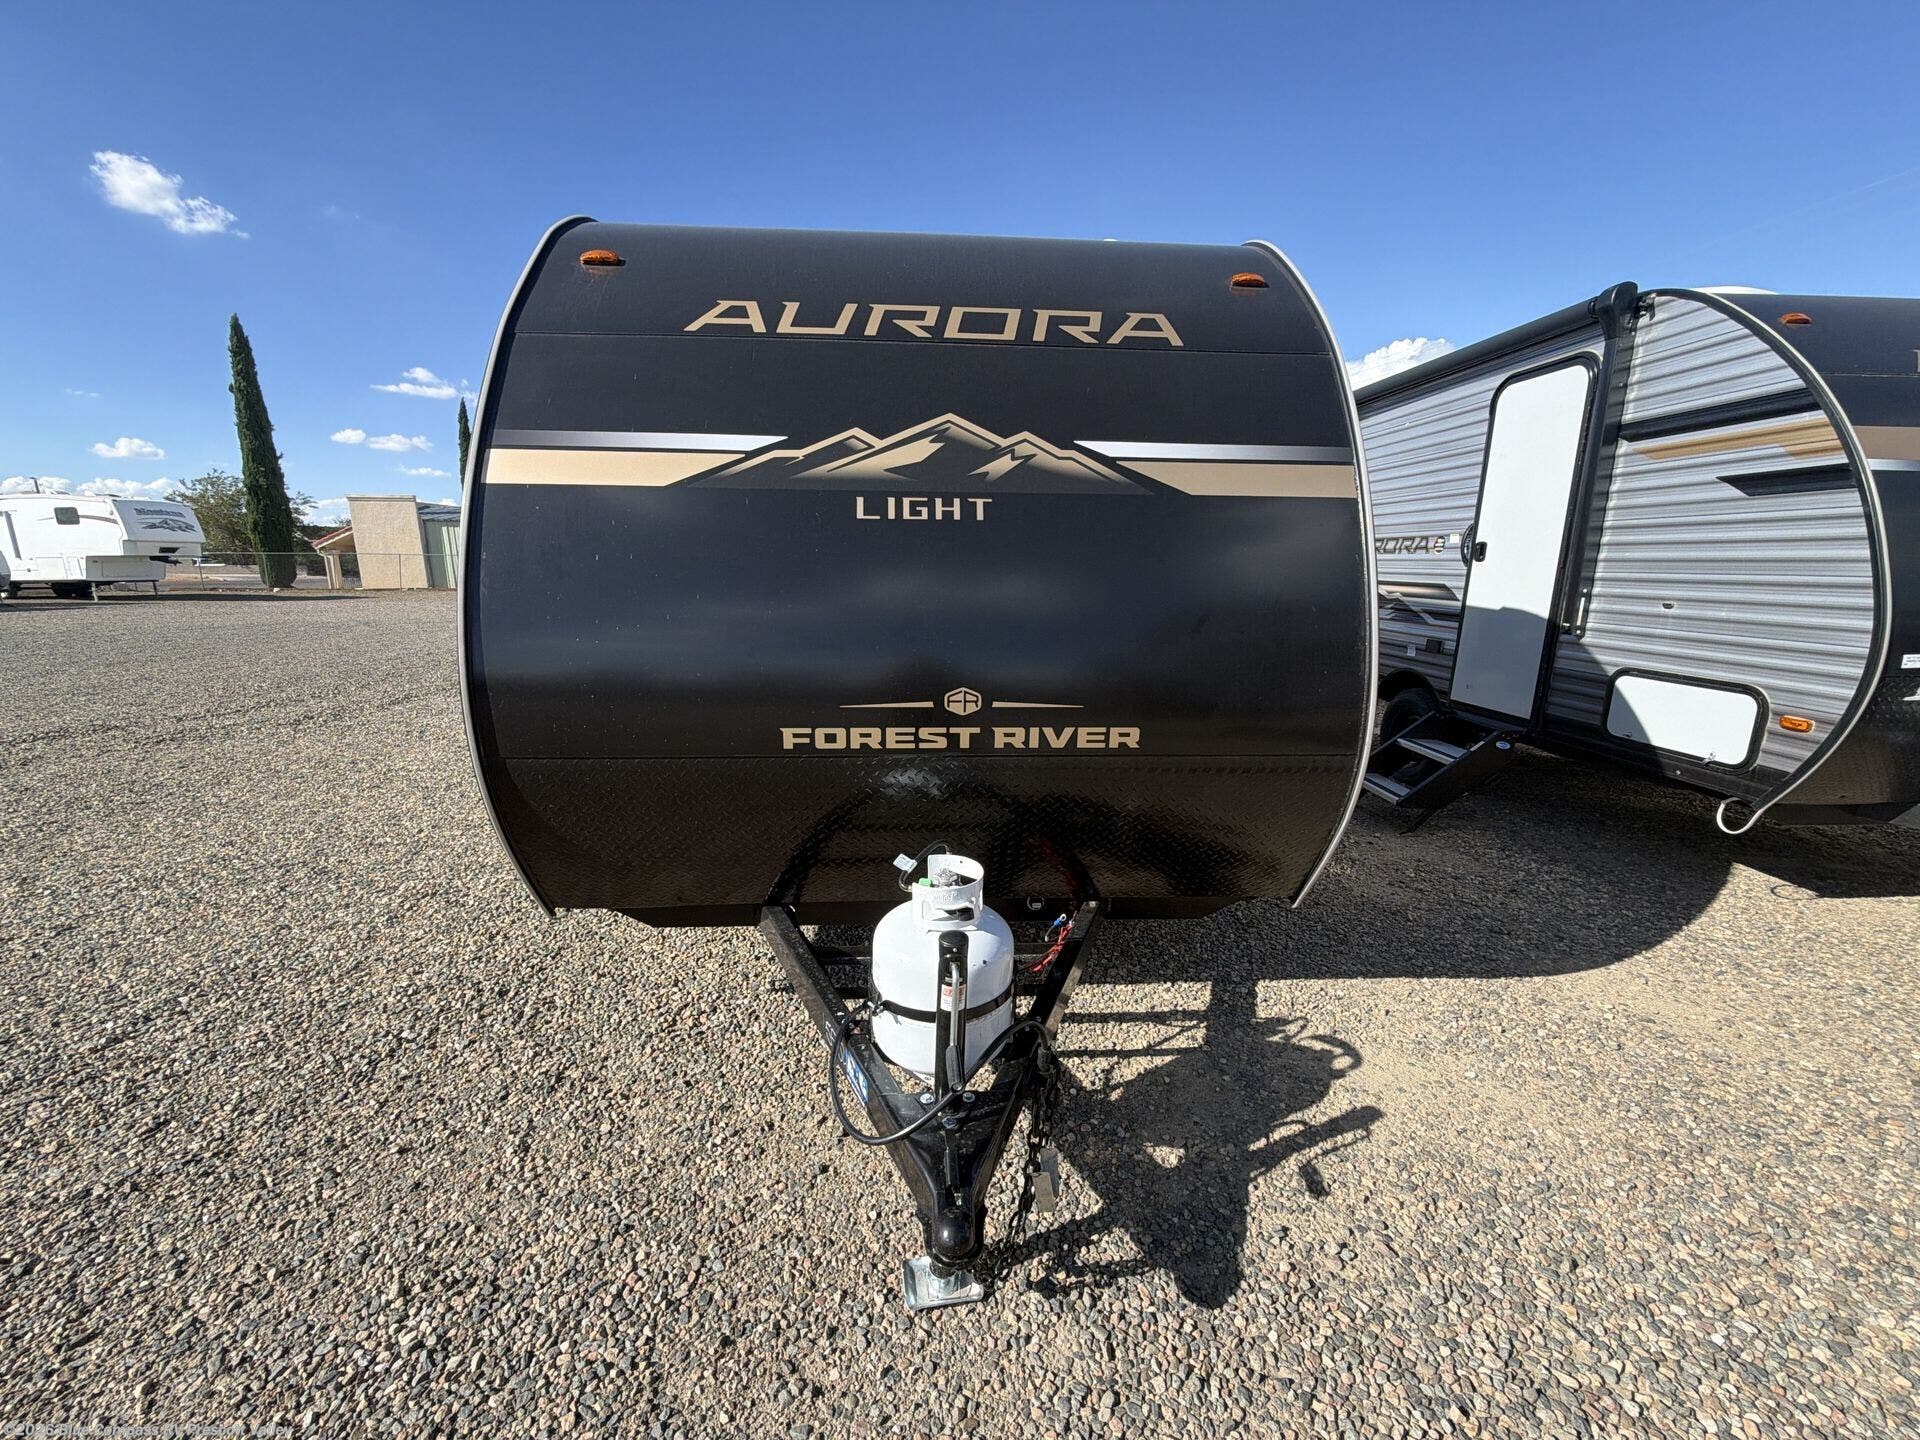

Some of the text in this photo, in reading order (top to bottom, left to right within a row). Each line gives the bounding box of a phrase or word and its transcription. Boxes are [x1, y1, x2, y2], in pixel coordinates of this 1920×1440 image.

[683, 300, 1185, 347] AURORA
[856, 496, 993, 521] LIGHT
[779, 727, 1141, 750] FOREST RIVER
